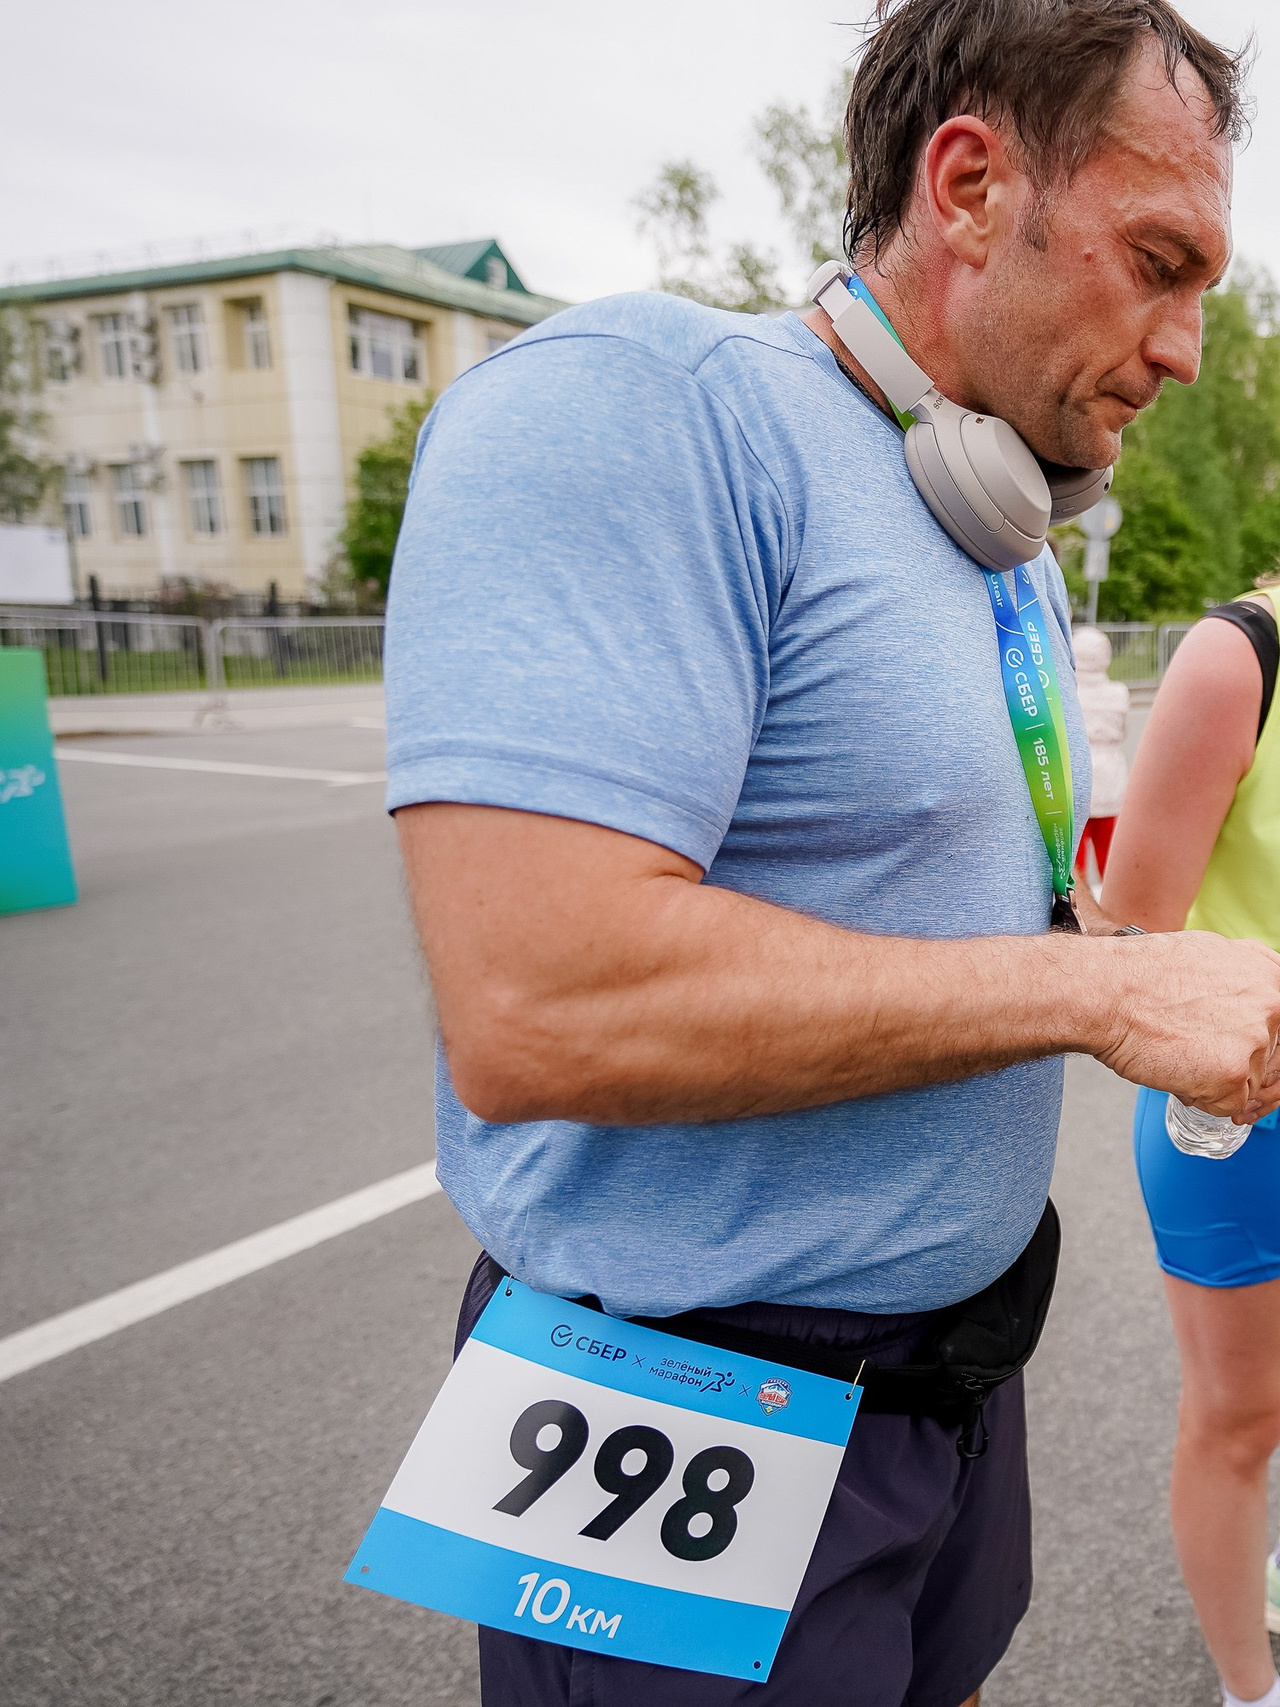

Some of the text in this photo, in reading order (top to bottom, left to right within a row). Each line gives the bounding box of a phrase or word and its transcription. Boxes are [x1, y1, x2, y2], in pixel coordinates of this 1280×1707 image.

[932, 394, 946, 410] SON
[1027, 621, 1044, 666] СБЕР
[1014, 671, 1038, 717] СБЕР
[1032, 737, 1055, 801] 185 лет
[575, 1335, 628, 1362] СБЕР
[649, 1365, 704, 1388] марафон
[660, 1356, 712, 1378] зелёный
[491, 1398, 756, 1563] 998
